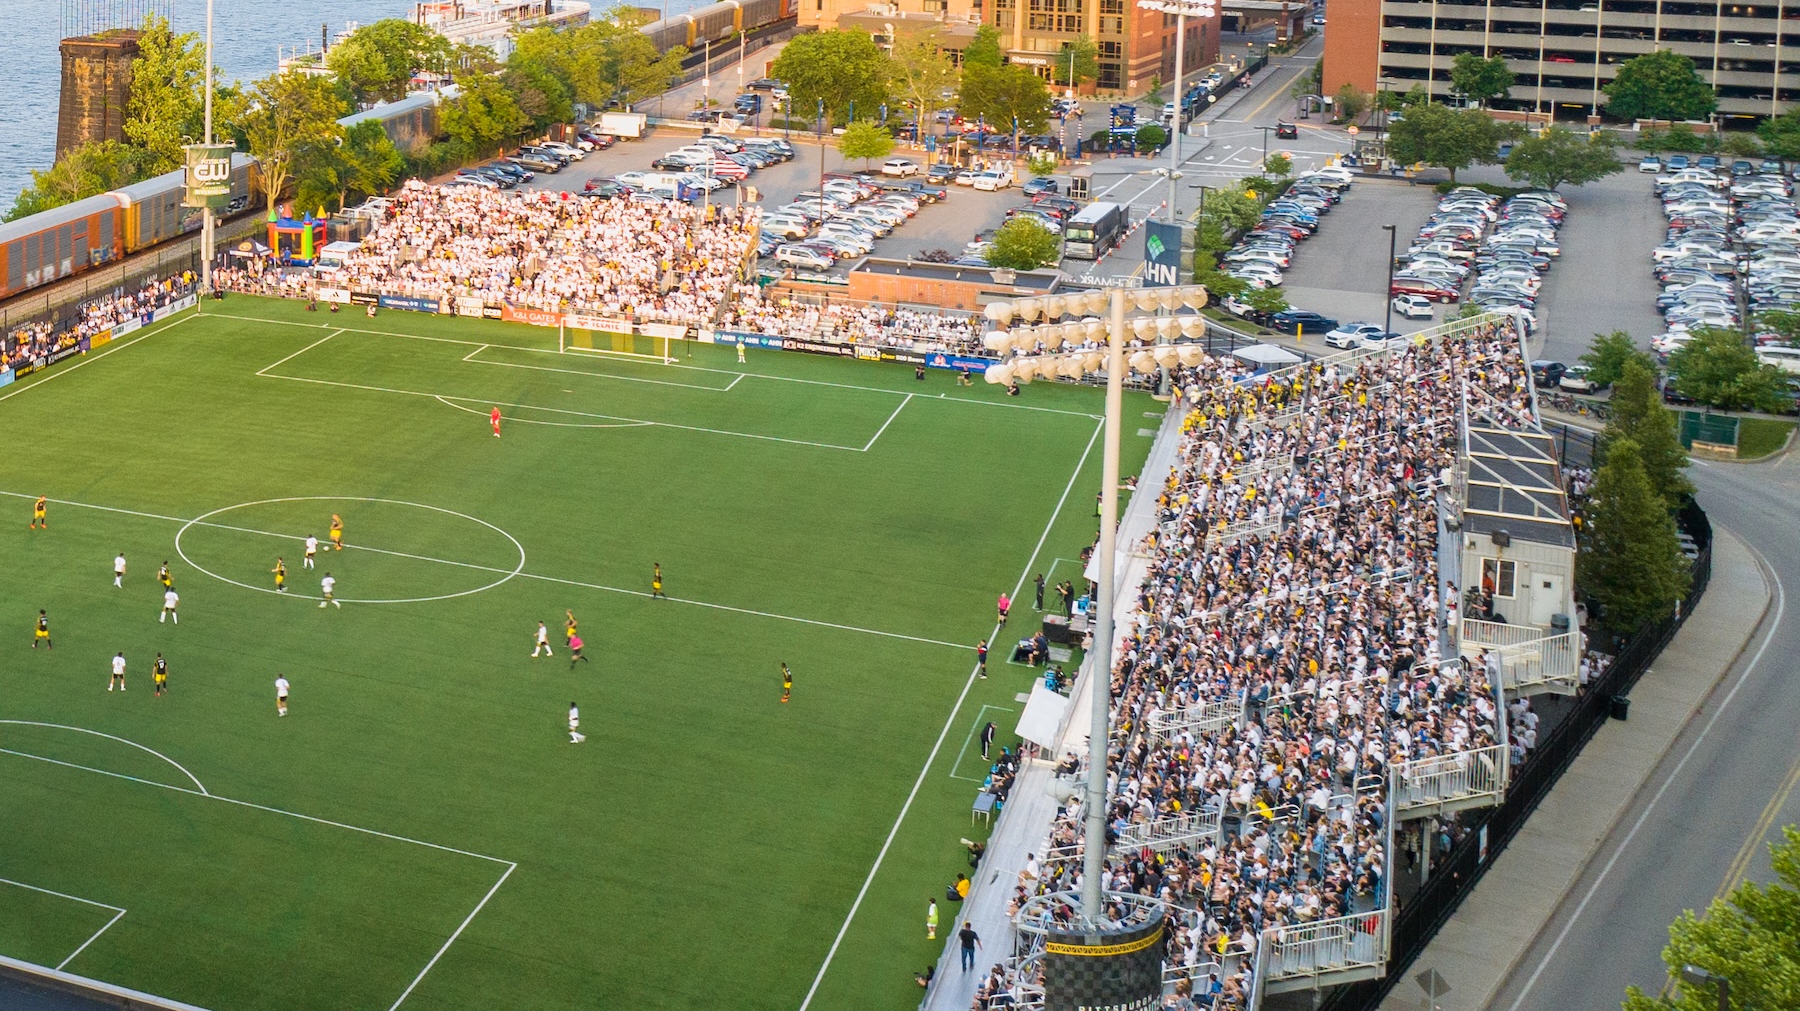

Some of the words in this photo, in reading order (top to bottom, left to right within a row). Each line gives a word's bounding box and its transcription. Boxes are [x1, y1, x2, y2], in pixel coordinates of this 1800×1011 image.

[1011, 56, 1047, 65] Sheraton
[194, 164, 229, 181] CW
[513, 312, 528, 320] K&L
[529, 313, 556, 323] GATES
[721, 334, 736, 342] AHN
